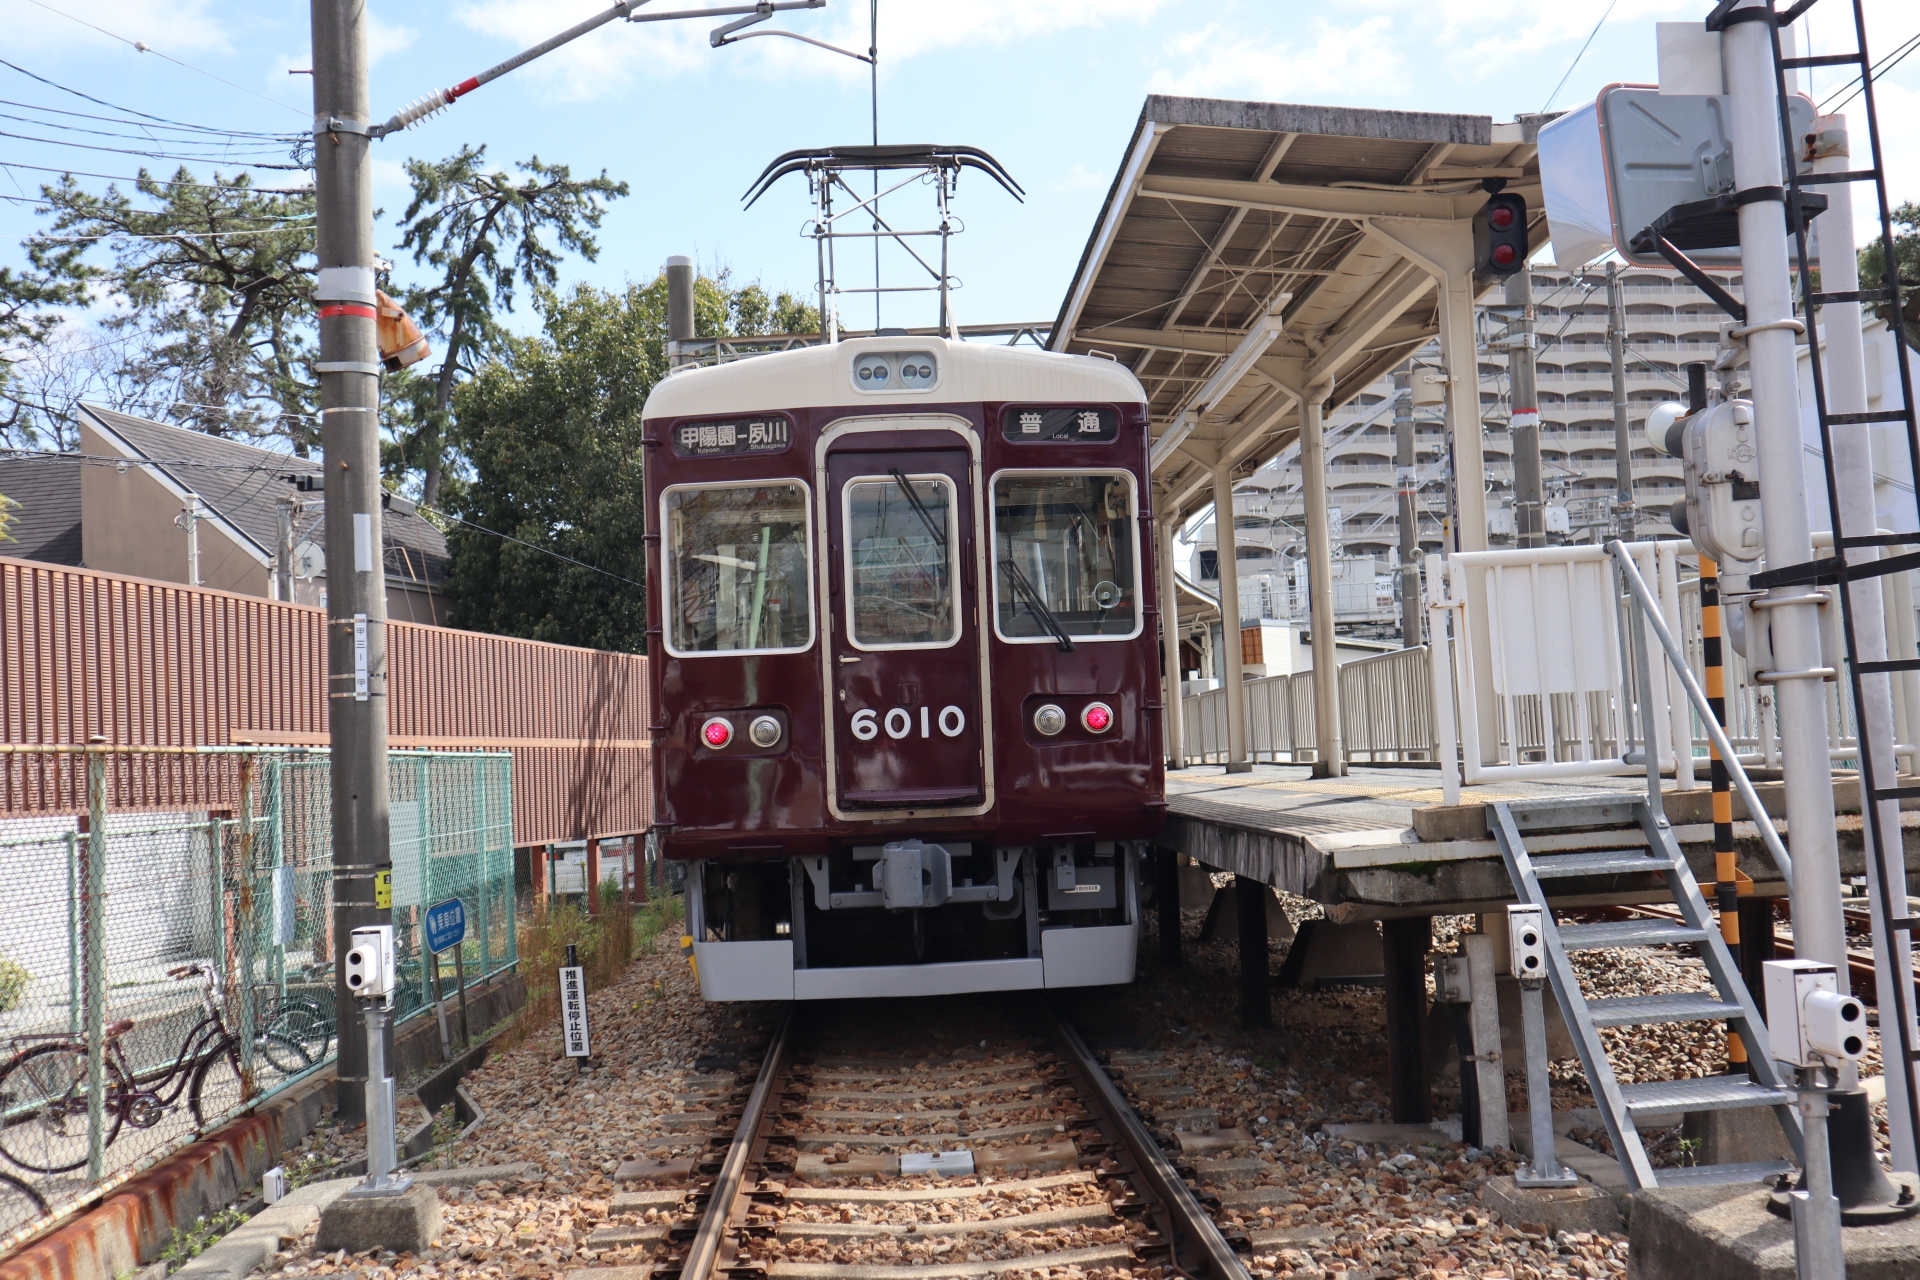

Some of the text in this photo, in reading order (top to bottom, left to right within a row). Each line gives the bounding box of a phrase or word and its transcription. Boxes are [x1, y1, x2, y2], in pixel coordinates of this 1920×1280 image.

[1019, 411, 1101, 433] 普通
[697, 446, 720, 455] Koyoen
[750, 442, 786, 450] Shukugawa
[851, 705, 966, 740] 6010
[437, 906, 462, 932] 乗車位置
[564, 969, 584, 1052] 推進運転停止位置
